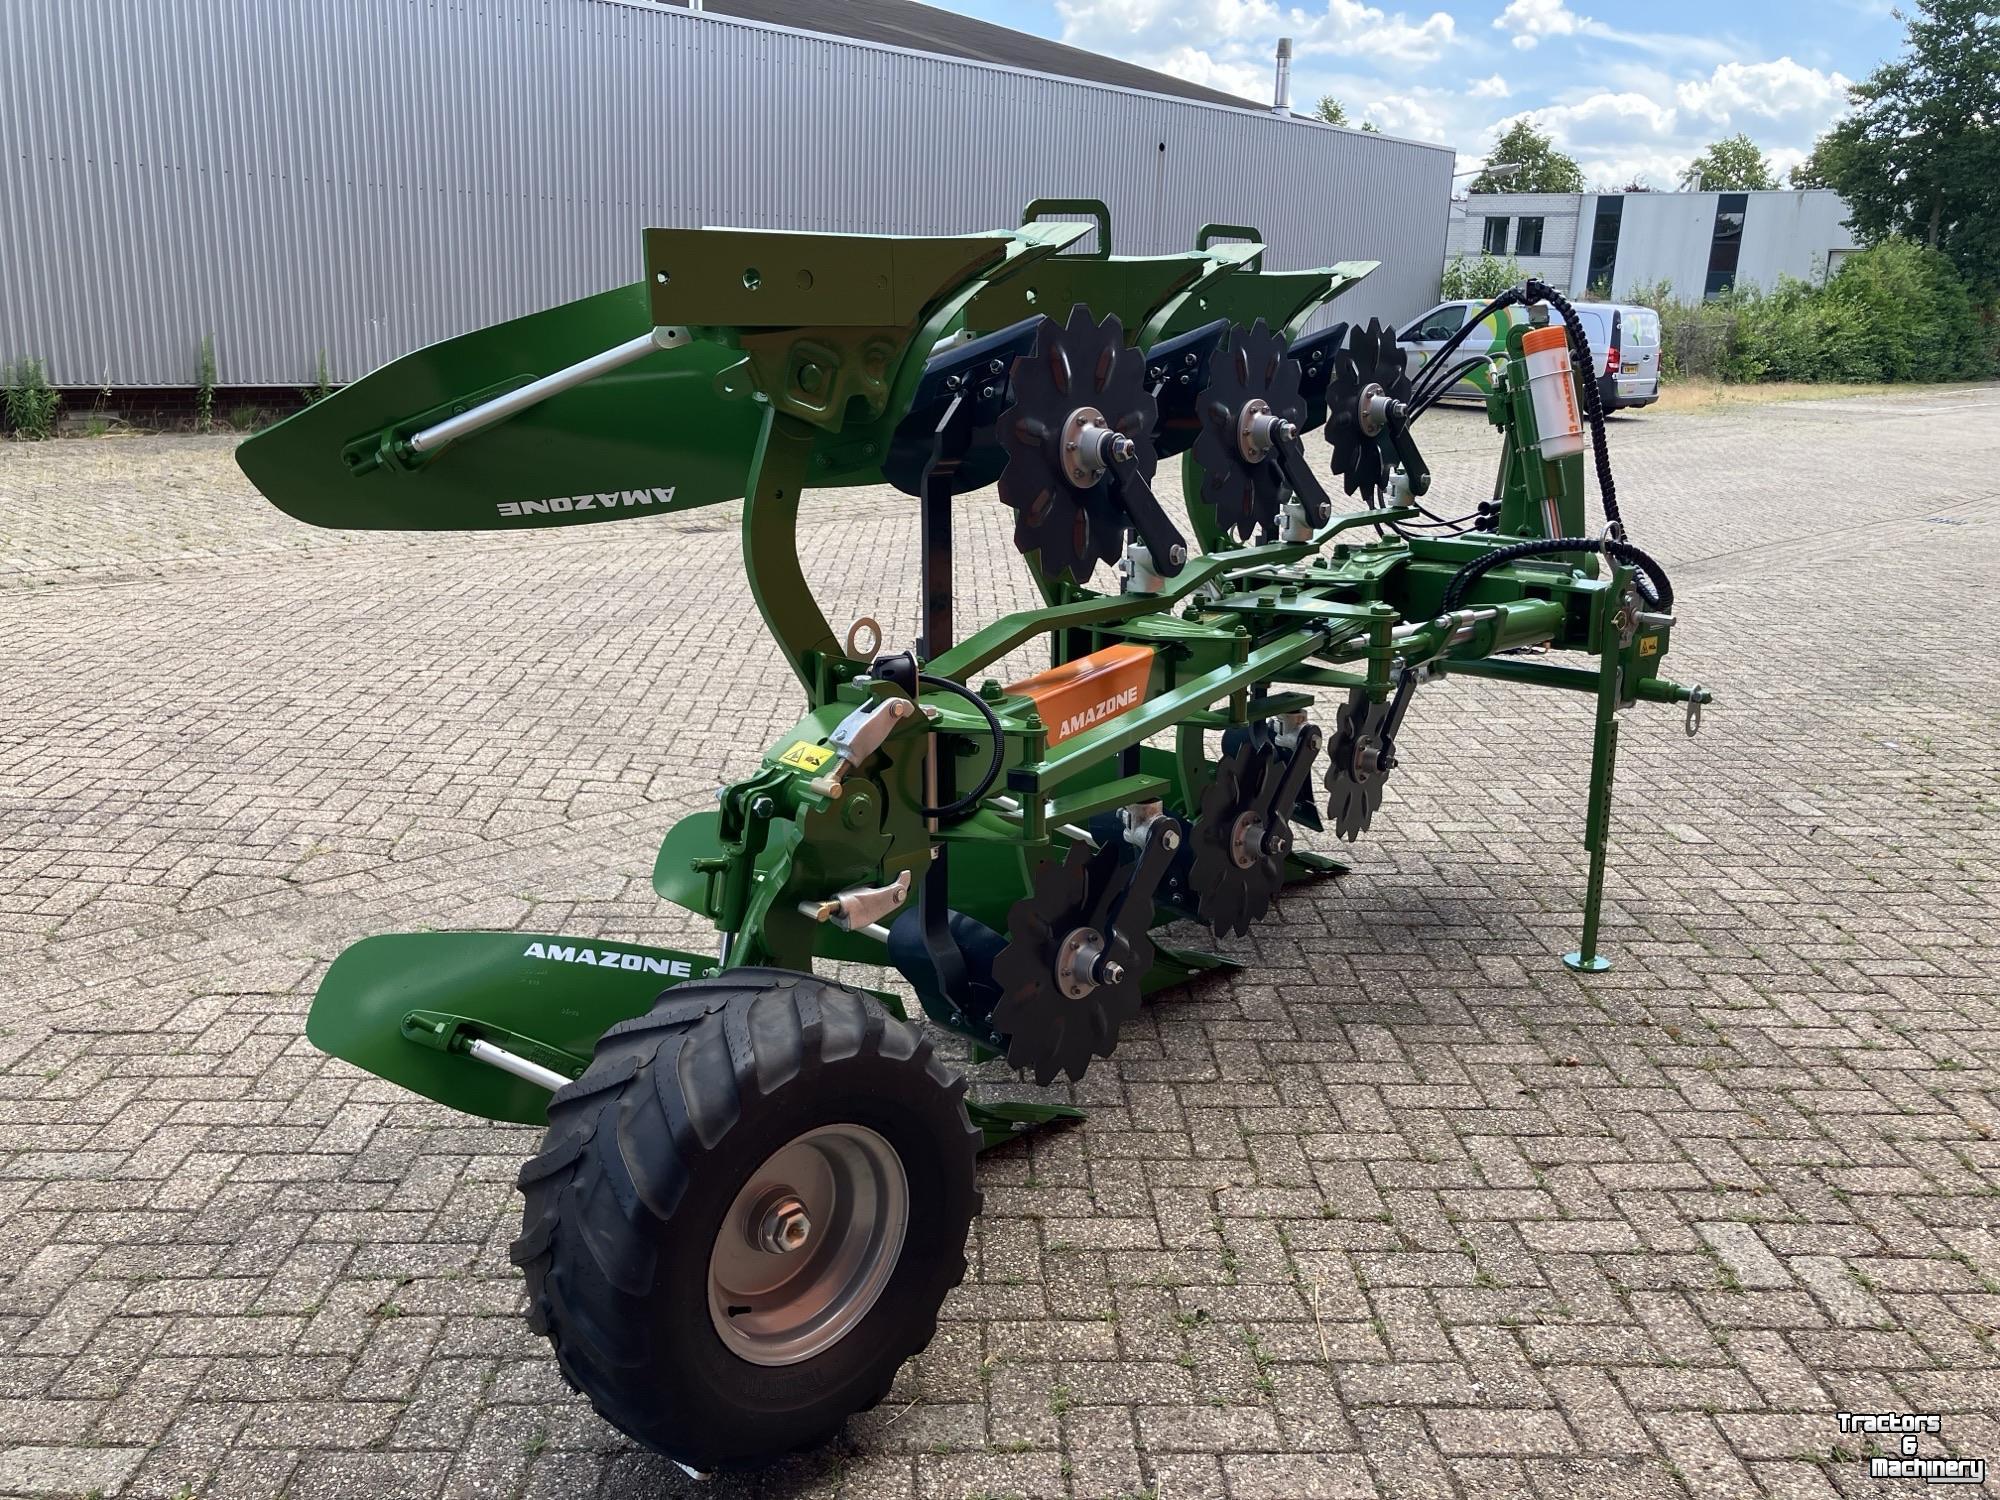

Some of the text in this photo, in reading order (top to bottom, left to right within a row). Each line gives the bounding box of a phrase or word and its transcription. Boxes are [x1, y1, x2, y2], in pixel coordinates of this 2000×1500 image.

[497, 486, 676, 517] AMAZONE
[1059, 686, 1138, 739] AMAZONE
[523, 942, 692, 978] AMAZONE
